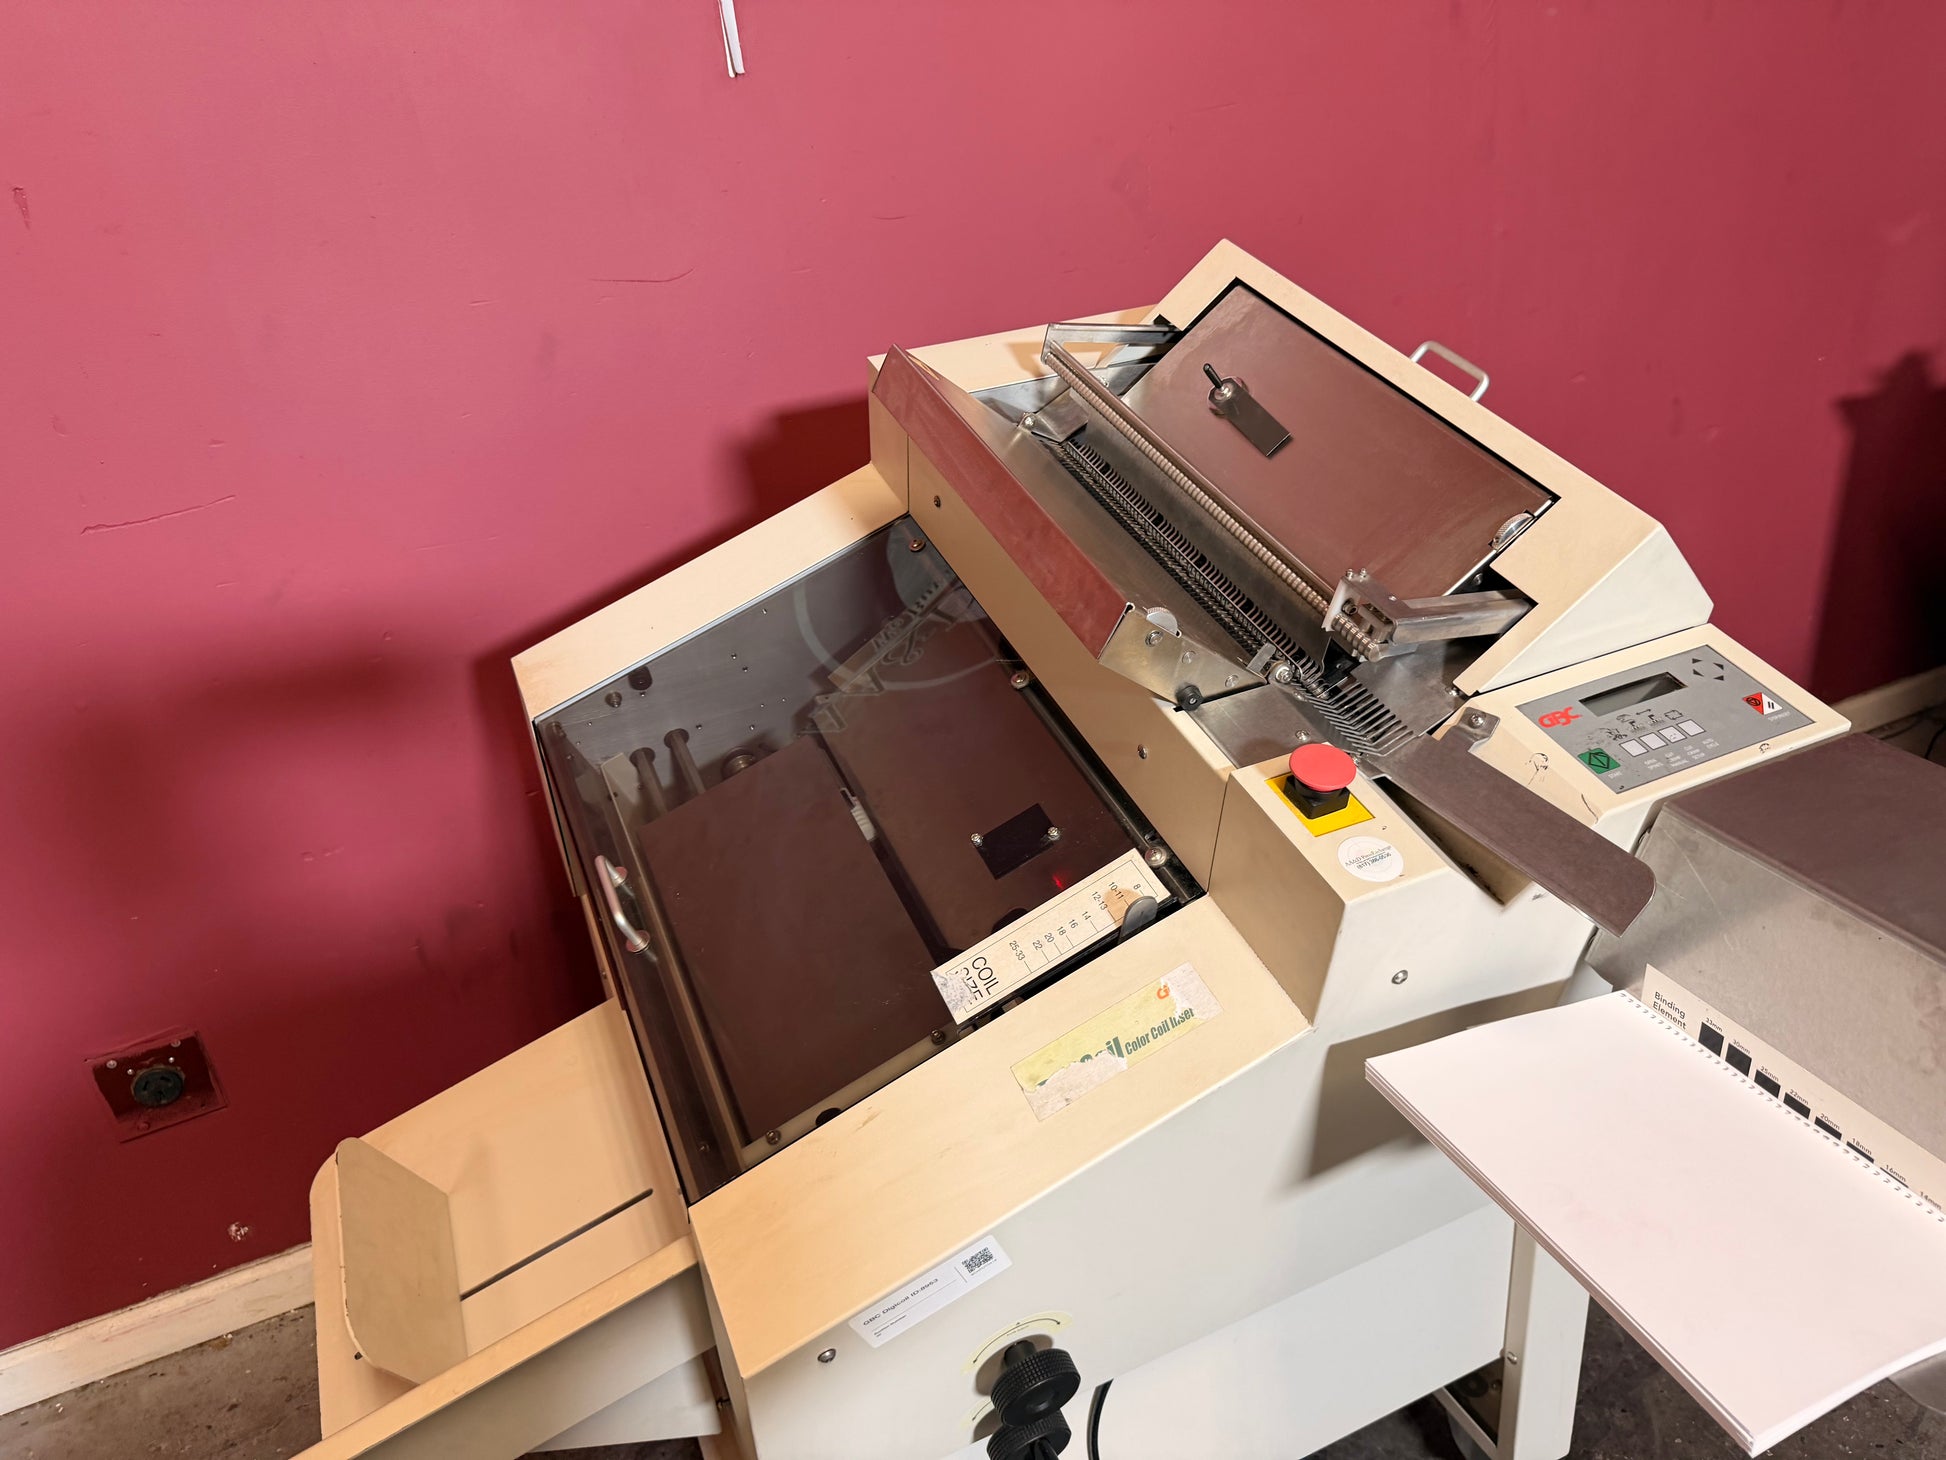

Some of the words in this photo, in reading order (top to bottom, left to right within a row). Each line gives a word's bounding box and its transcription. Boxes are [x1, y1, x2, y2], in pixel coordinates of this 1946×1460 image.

[1538, 706, 1581, 729] GBC
[1108, 881, 1124, 900] 10-11
[1092, 891, 1108, 911] 12-13
[1068, 919, 1079, 929] 16
[1081, 911, 1091, 921] 14
[1044, 932, 1055, 943] 20
[1057, 926, 1067, 936] 18
[1009, 940, 1026, 961] 25-33
[1032, 940, 1043, 950] 22
[972, 956, 999, 995] COIL
[1654, 991, 1686, 1019] Binding
[1653, 1001, 1687, 1030] Element
[1124, 1033, 1151, 1055] Color
[1150, 1019, 1170, 1040] Coil
[1760, 1066, 1779, 1081] 25mm
[1789, 1089, 1809, 1106] 22mm
[1820, 1113, 1840, 1130] 20mm
[1851, 1138, 1872, 1155] 18mm
[1885, 1164, 1907, 1183] 16mm
[1919, 1191, 1942, 1210] 14mm
